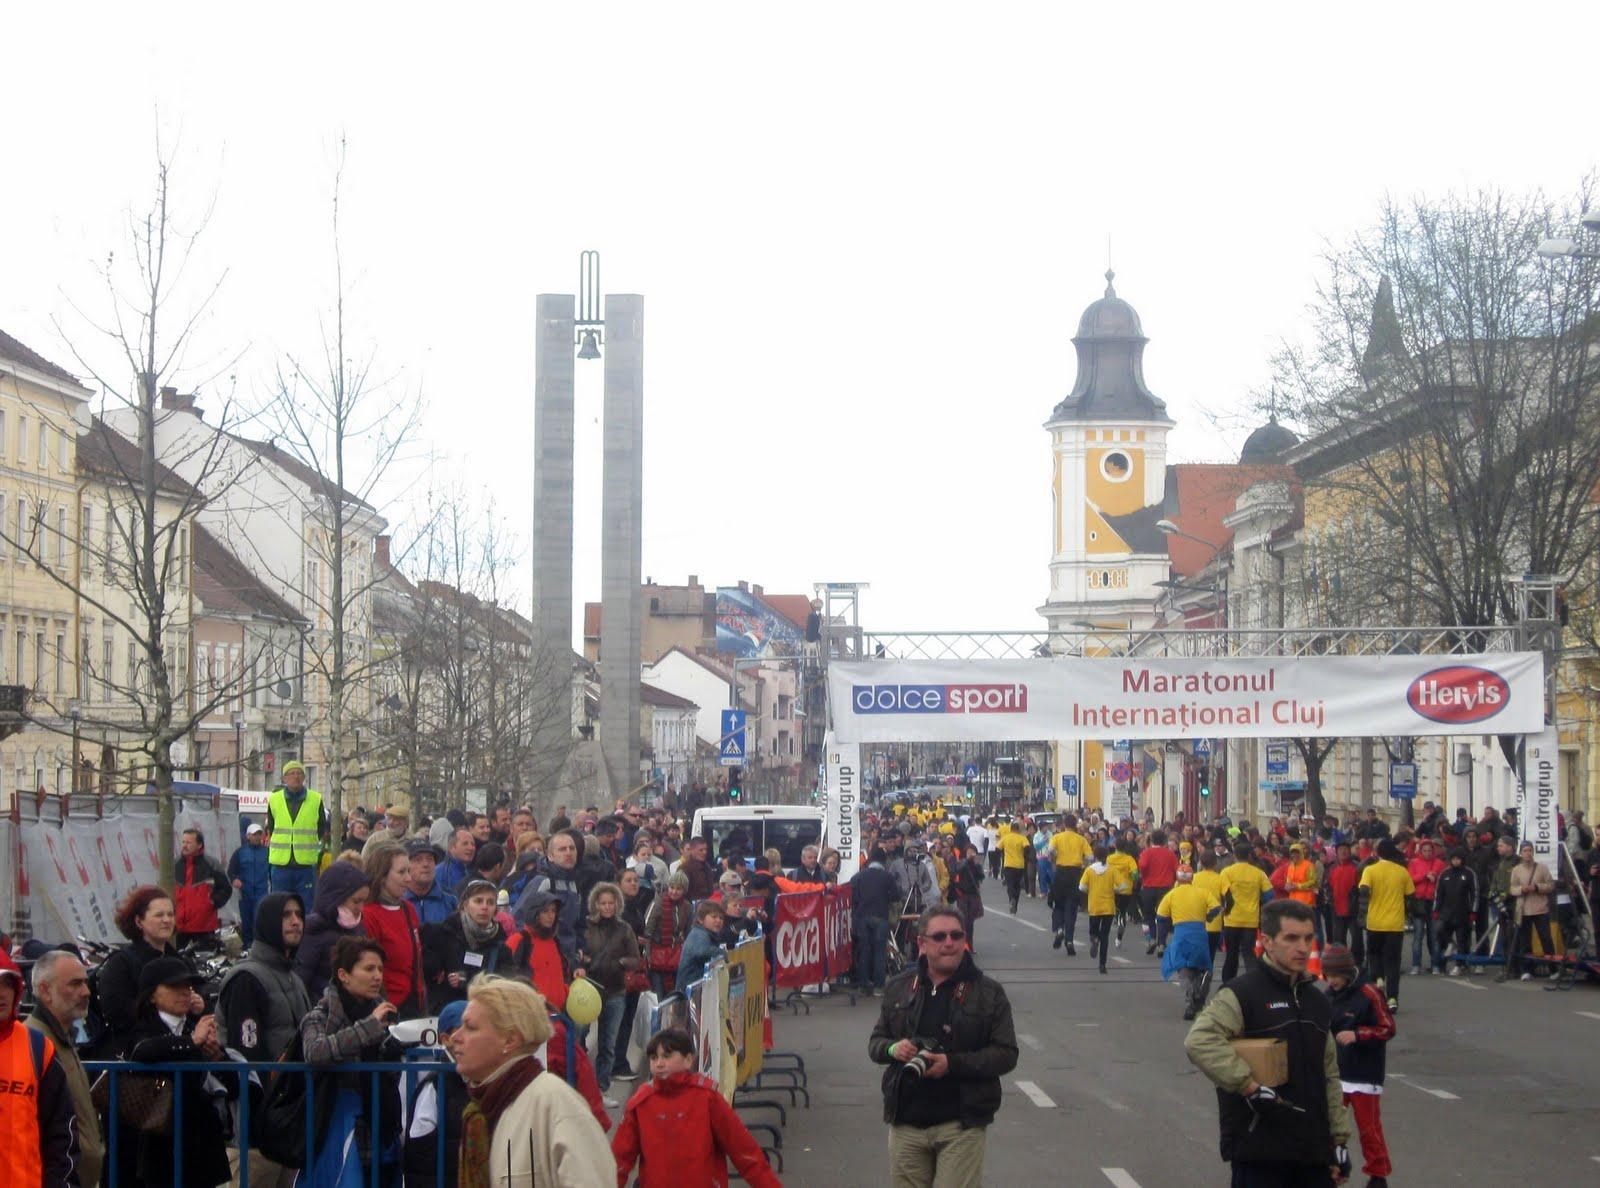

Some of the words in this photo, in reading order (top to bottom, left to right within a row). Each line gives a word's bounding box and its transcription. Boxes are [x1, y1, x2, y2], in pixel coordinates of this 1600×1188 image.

[1122, 668, 1275, 695] Maratonul
[1419, 679, 1502, 711] Hervis
[856, 684, 942, 710] dolce
[949, 683, 1024, 714] sport
[1272, 699, 1327, 729] Cluj
[837, 765, 855, 861] Electrogrup
[1535, 760, 1554, 855] Electrogrup
[776, 917, 820, 969] cora
